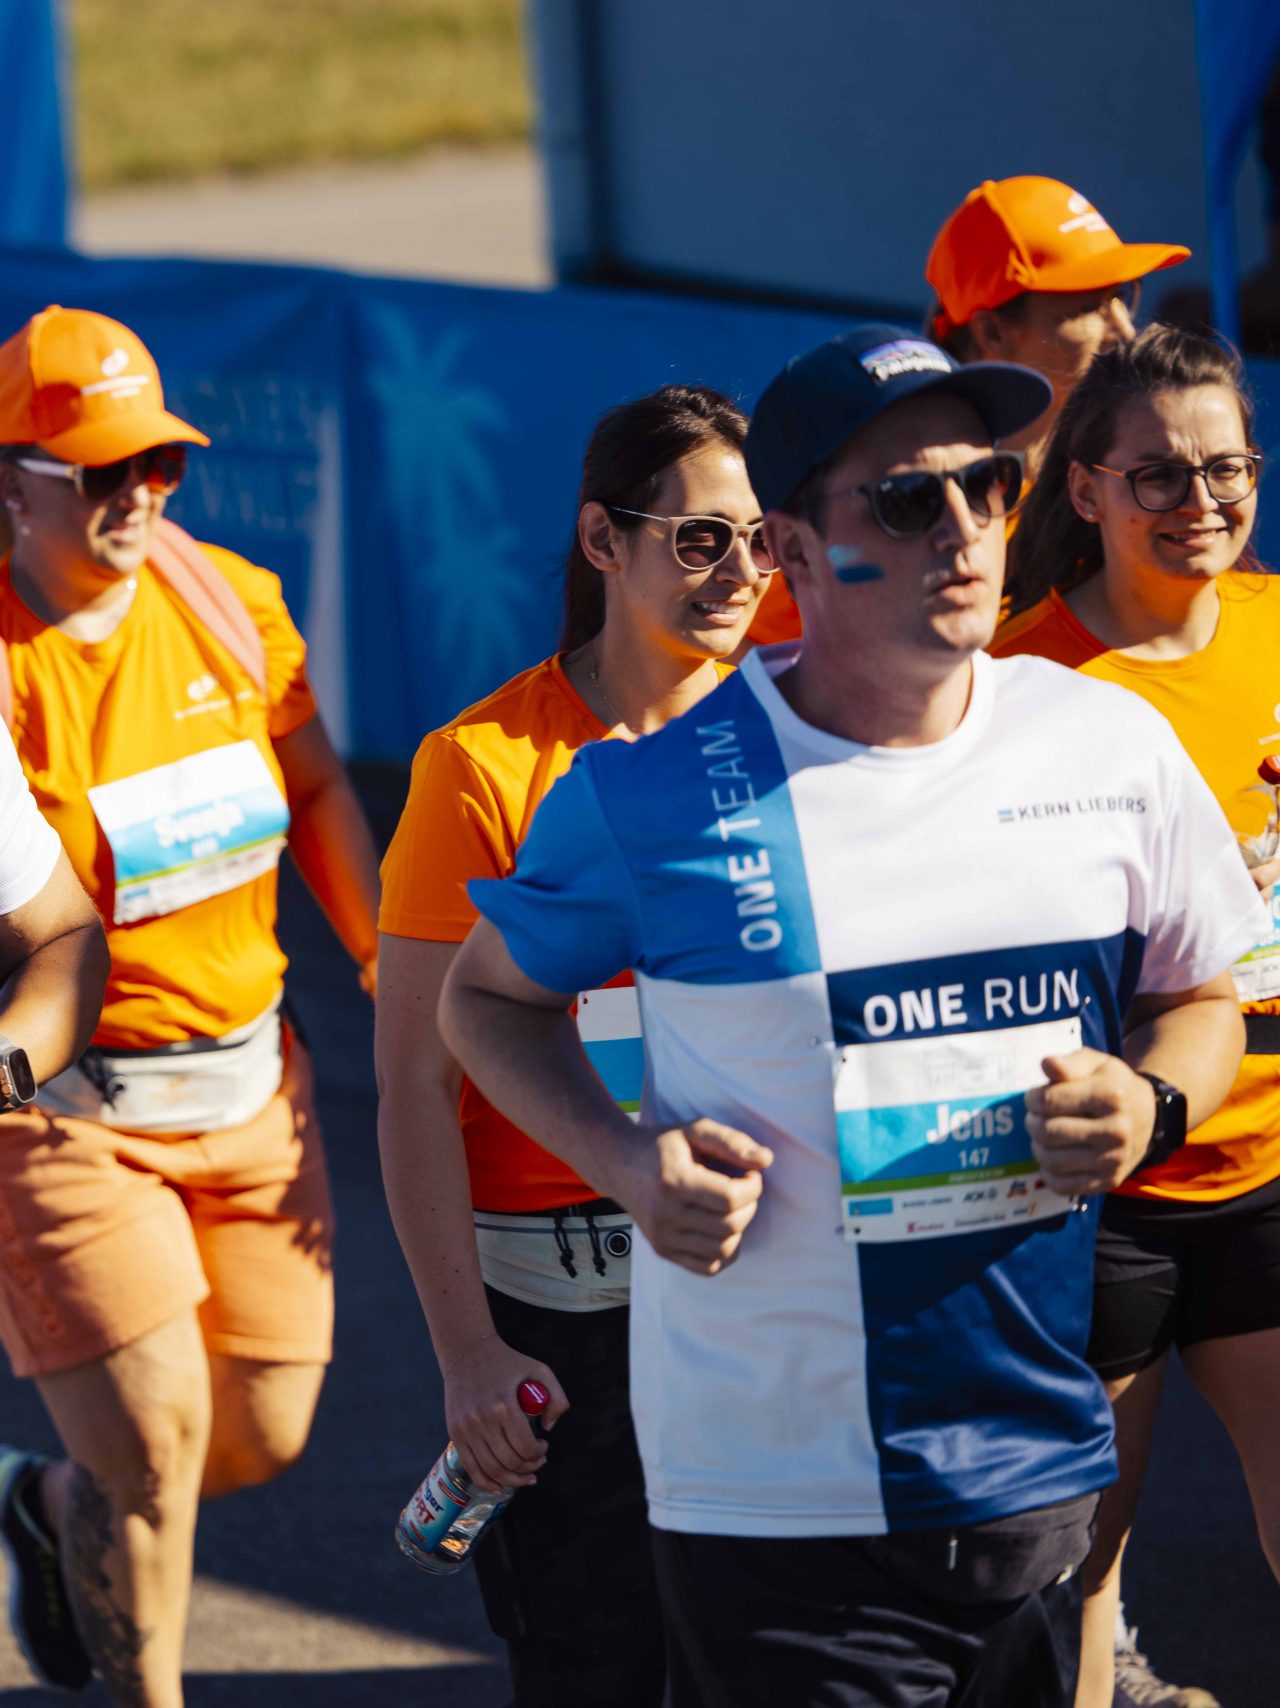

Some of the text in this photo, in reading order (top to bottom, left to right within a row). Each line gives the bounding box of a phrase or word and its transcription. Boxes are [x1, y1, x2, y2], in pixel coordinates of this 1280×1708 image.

[1018, 797, 1146, 820] KERN LIEBERS
[696, 719, 783, 952] ONE TEAM
[863, 968, 1079, 1037] ONE RUN
[926, 1103, 1014, 1144] Jens
[959, 1148, 990, 1168] 147
